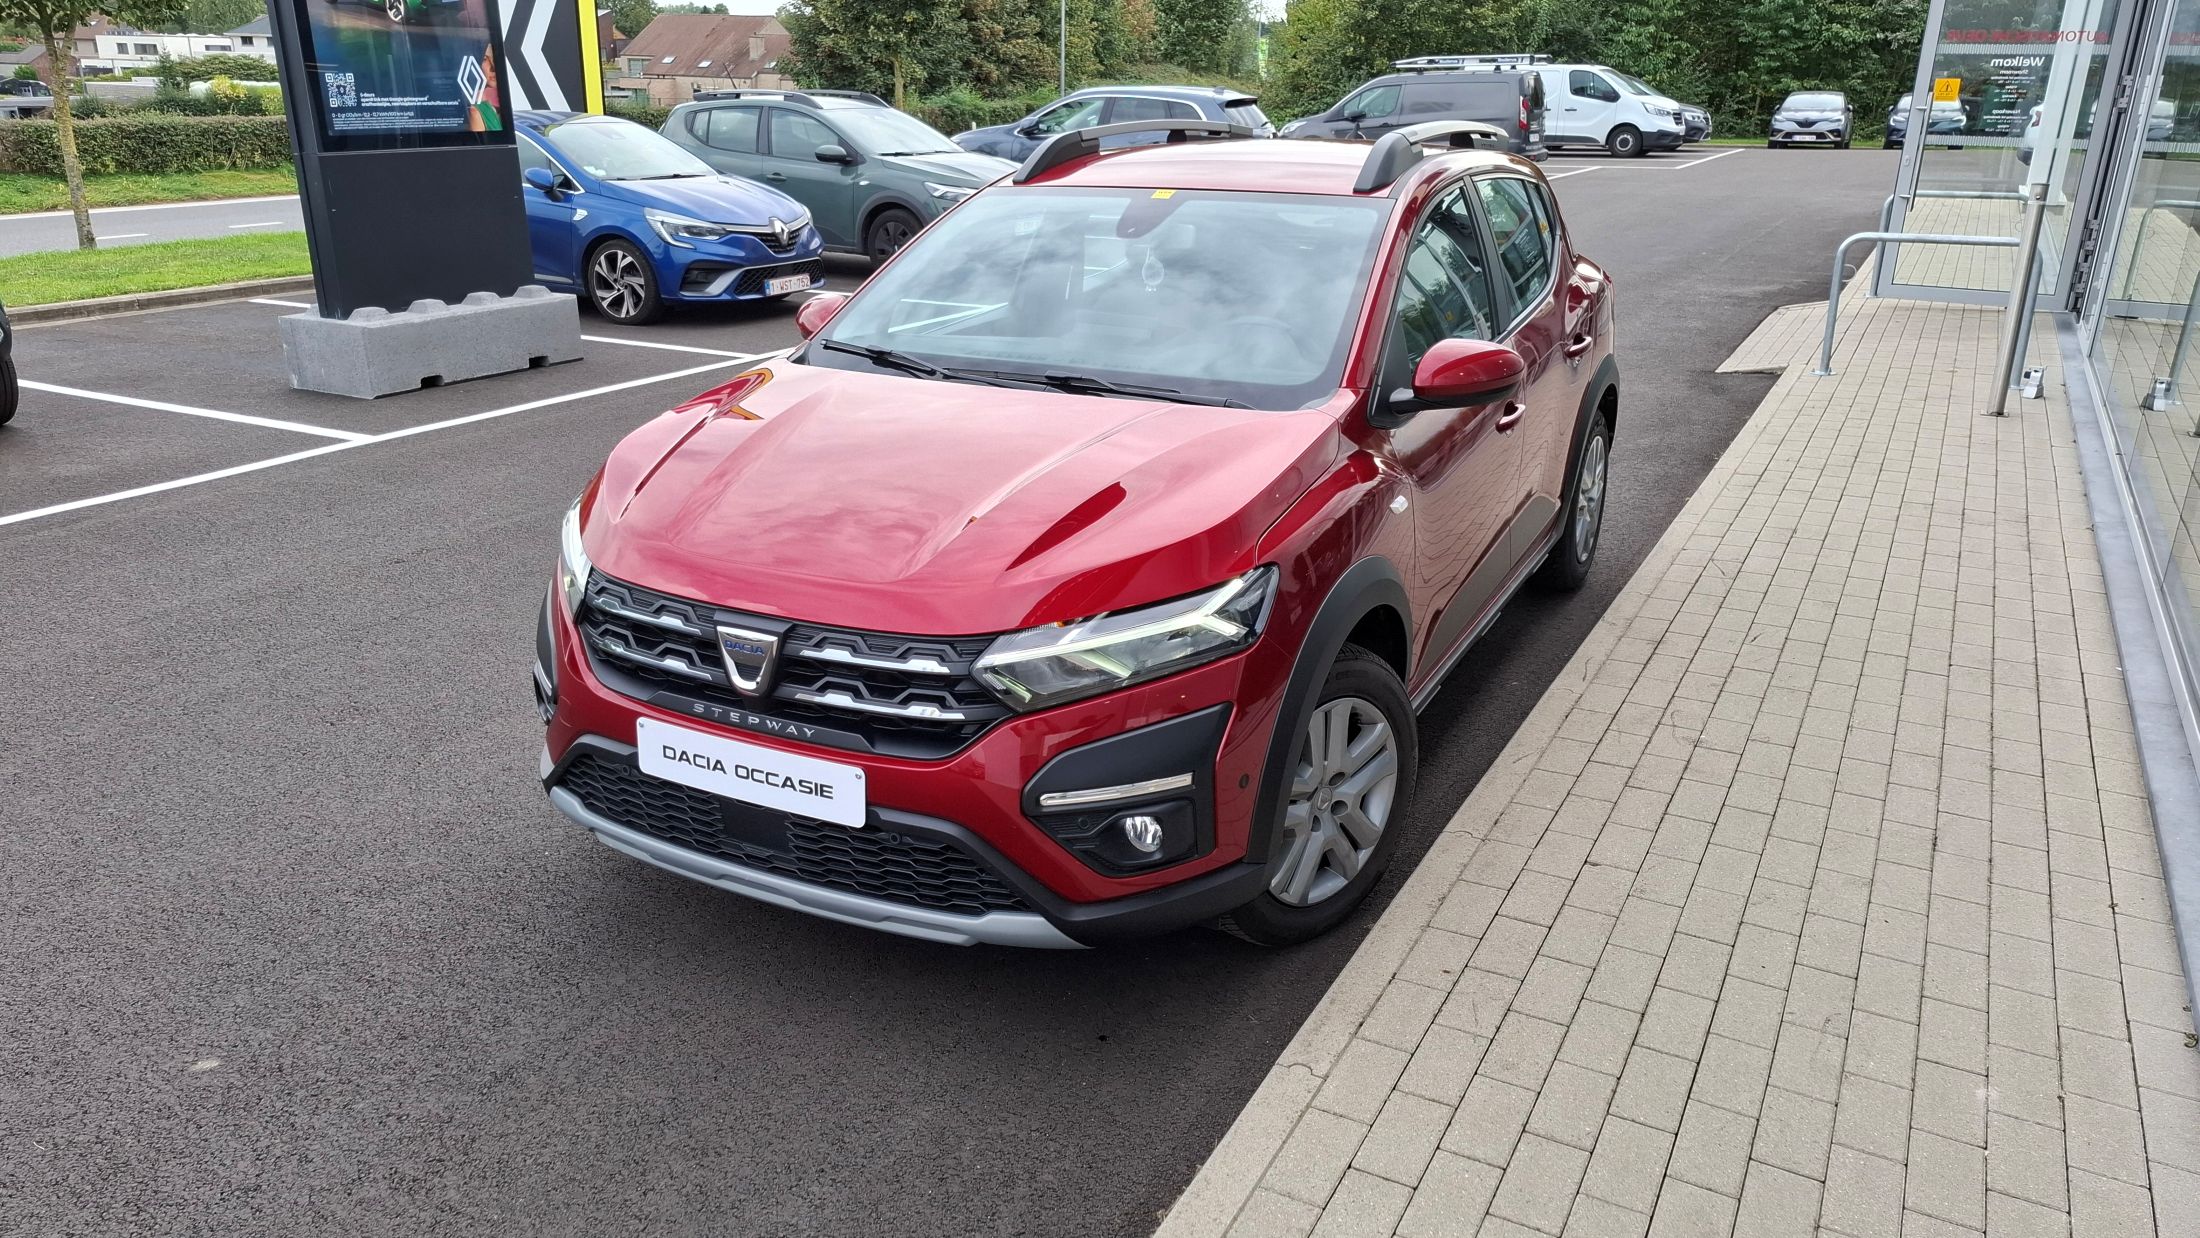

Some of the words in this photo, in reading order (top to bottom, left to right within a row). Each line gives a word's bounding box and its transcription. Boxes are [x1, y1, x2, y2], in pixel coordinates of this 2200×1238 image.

[724, 640, 765, 656] DACIA
[693, 703, 816, 738] STEPWAY
[662, 744, 727, 774] DACIA
[735, 764, 834, 800] OCCASIE
